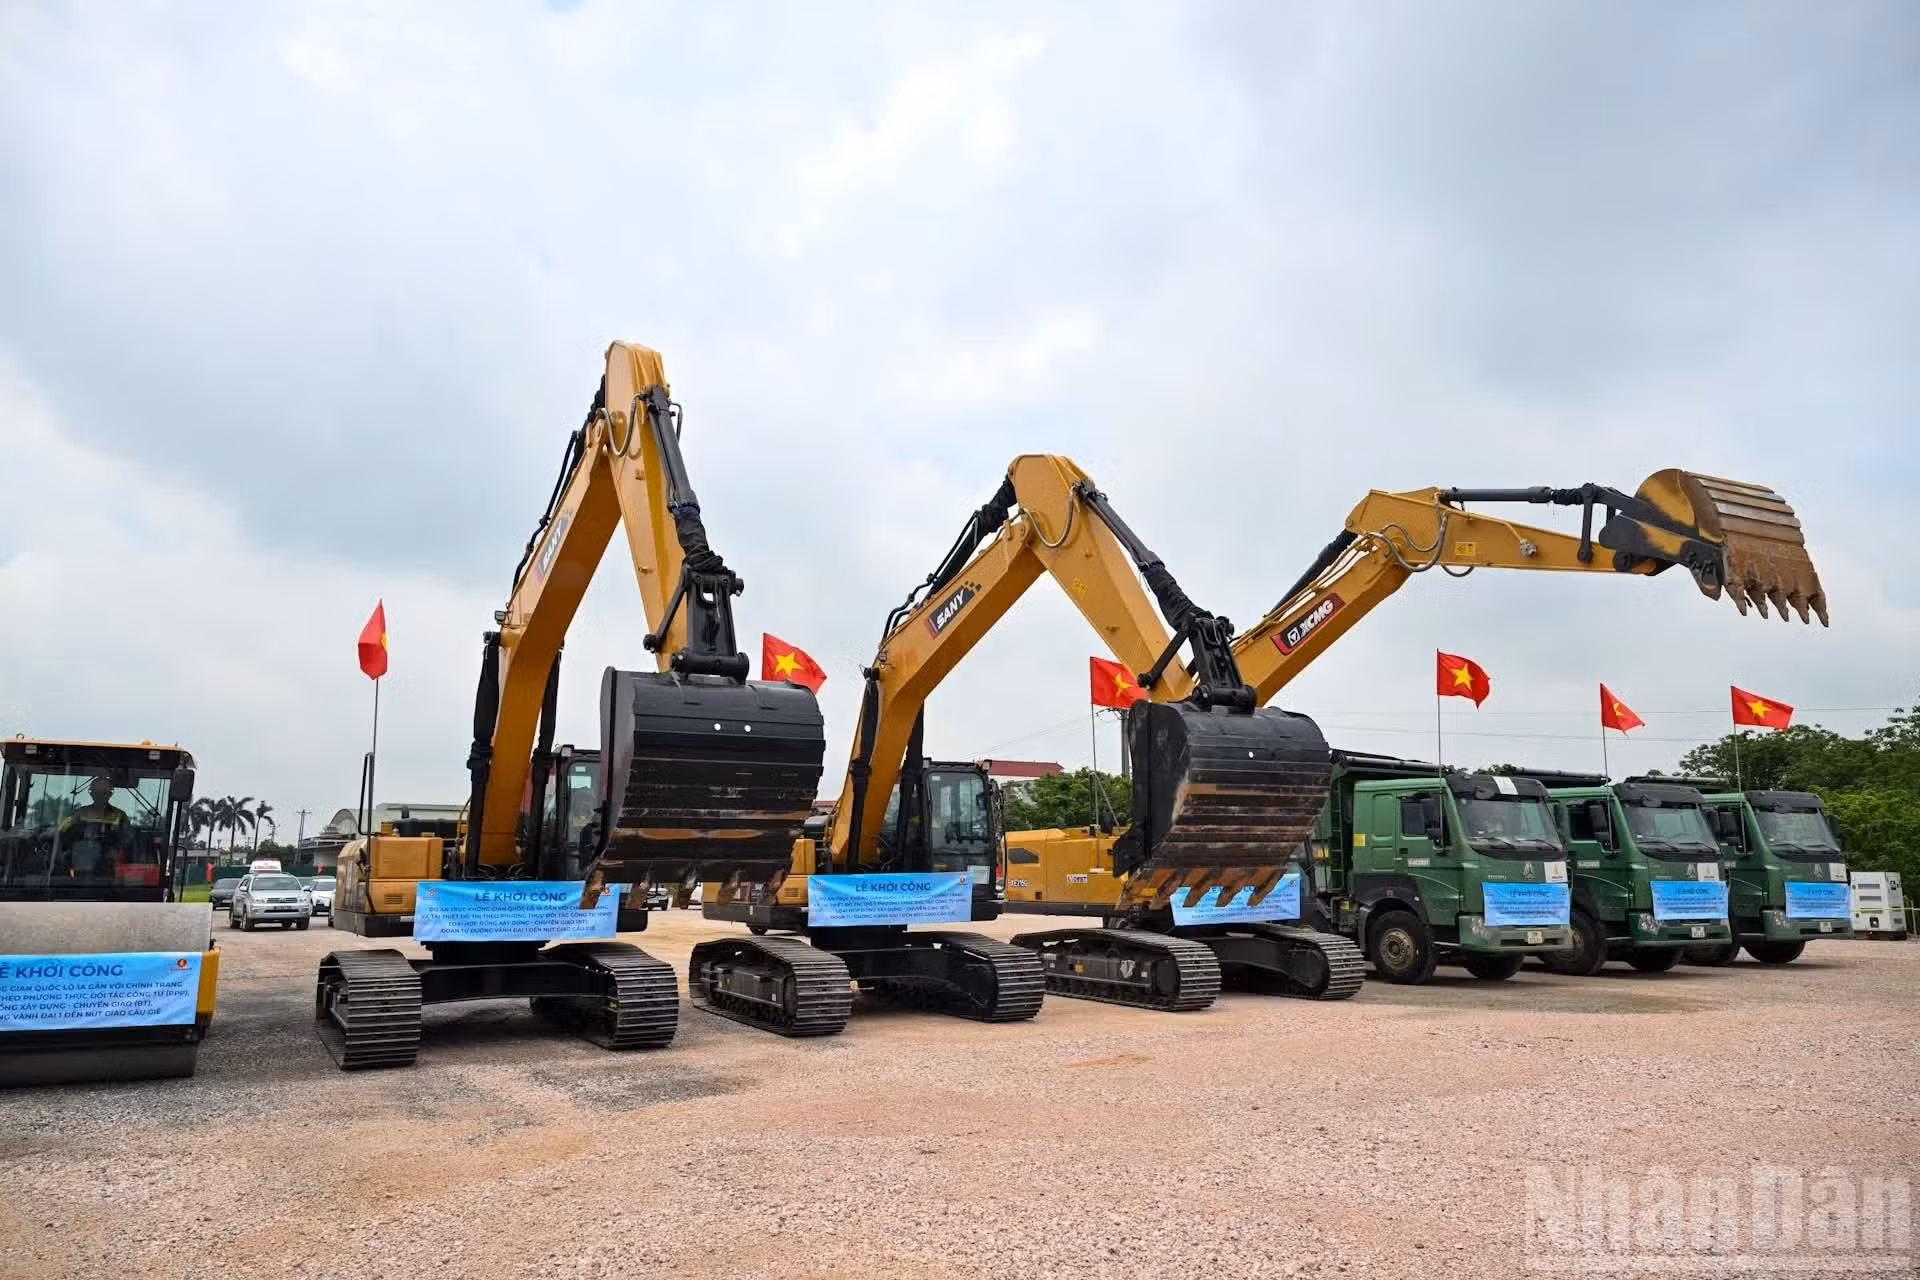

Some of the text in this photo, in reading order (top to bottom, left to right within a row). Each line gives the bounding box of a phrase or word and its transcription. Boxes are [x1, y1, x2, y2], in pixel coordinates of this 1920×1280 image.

[937, 589, 964, 629] SANY
[1299, 600, 1334, 638] XCMG
[0, 961, 123, 979] Ễ KHỞI CÔNG
